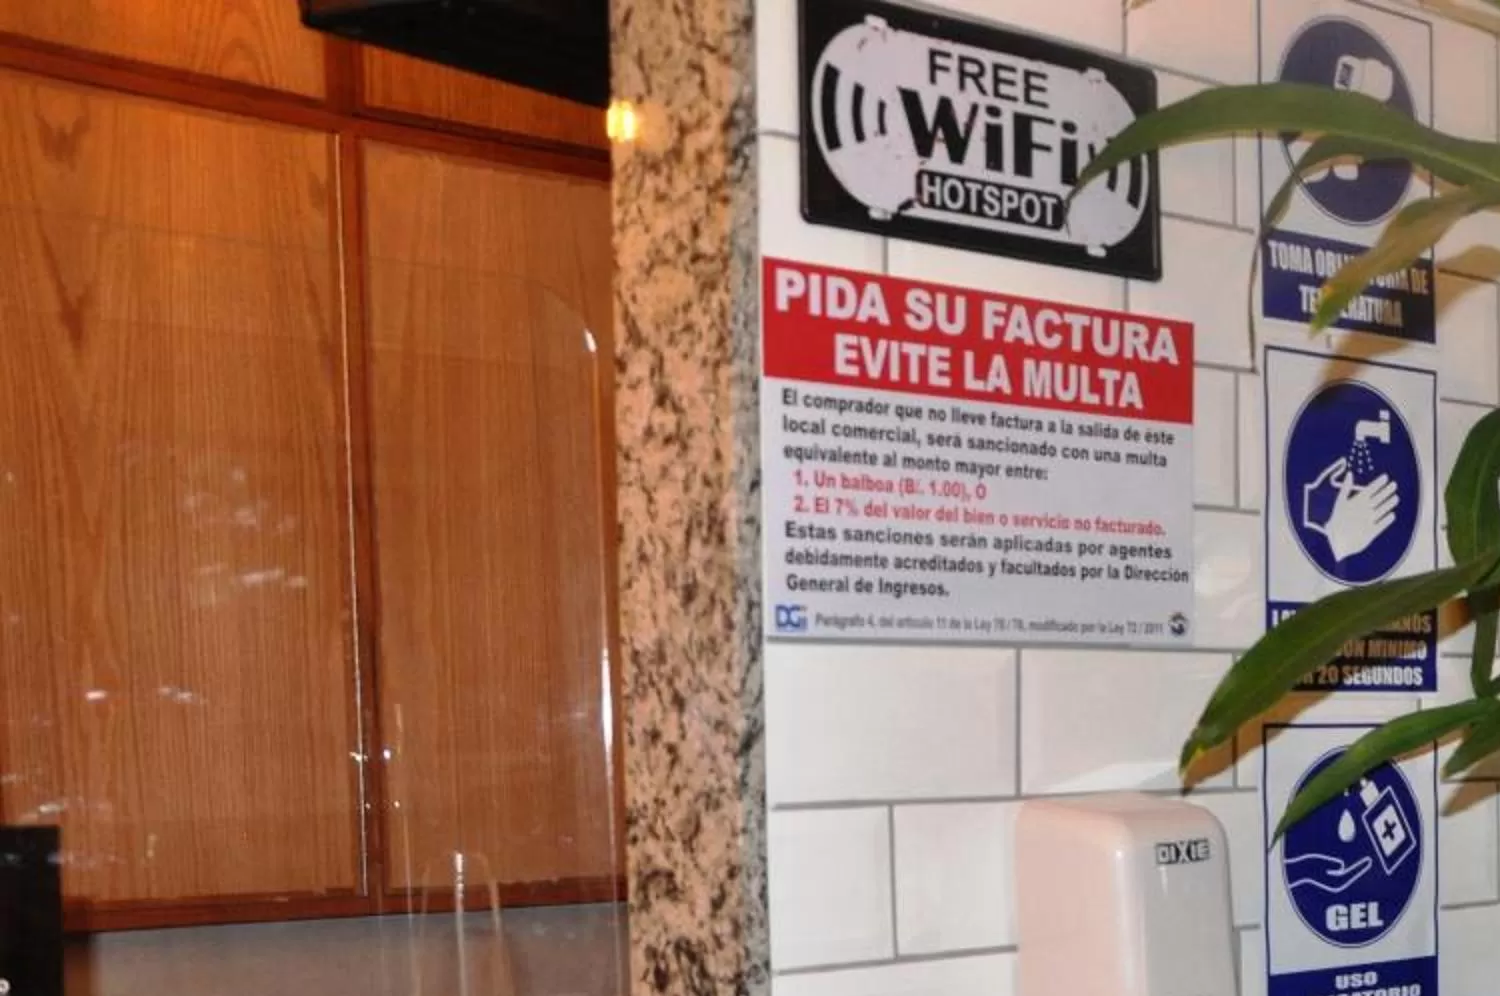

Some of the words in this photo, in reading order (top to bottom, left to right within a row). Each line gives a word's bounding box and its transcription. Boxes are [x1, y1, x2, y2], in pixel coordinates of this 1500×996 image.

[927, 48, 1050, 109] FREE
[896, 85, 1081, 187] WiFi
[921, 174, 1059, 227] HOTSPOT
[1267, 239, 1313, 275] TOMA
[1314, 248, 1409, 291] OBLORIA
[1410, 267, 1429, 295] DE
[774, 267, 890, 327] PIDA
[904, 288, 966, 336] SU
[982, 300, 1179, 366] FACTURA
[1298, 283, 1403, 327] TERATURA
[833, 332, 952, 387] EVITE
[964, 350, 1012, 397] LA
[1022, 360, 1144, 410] MULTA
[781, 387, 798, 405] El
[802, 393, 890, 416] comprador
[894, 405, 923, 422] que
[928, 407, 947, 422] no
[951, 407, 986, 426] lleve
[991, 412, 1043, 431] factura
[1047, 420, 1057, 433] a
[1061, 419, 1074, 435] la
[1077, 422, 1119, 440] salida
[1123, 425, 1142, 442] de
[782, 413, 826, 435] local
[831, 423, 921, 447] comercial,
[966, 435, 1057, 458] sancionado
[1060, 445, 1089, 461] con
[1093, 449, 1121, 463] una
[1125, 450, 1167, 468] multa
[783, 443, 878, 466] equivalente
[882, 451, 897, 468] al
[901, 455, 951, 472] monto
[955, 461, 1000, 480] mayor
[1005, 463, 1049, 480] entre:
[793, 470, 809, 487] 1.
[813, 470, 837, 489] Un
[840, 474, 895, 494] balboa
[793, 495, 810, 513] 2.
[814, 497, 830, 513] El
[836, 499, 860, 516] 7%
[863, 501, 889, 518] del
[892, 504, 932, 521] valor
[934, 505, 959, 523] del
[963, 508, 994, 525] bien
[999, 513, 1009, 527] o
[1012, 513, 1070, 530] servicio
[1073, 518, 1092, 532] no
[1095, 516, 1167, 536] facturado.
[784, 520, 838, 540] Estas
[843, 526, 935, 546] sanciones
[939, 531, 989, 548] serán
[993, 534, 1073, 555] aplicadas
[1077, 541, 1105, 558] por
[1109, 544, 1173, 561] agentes
[784, 547, 890, 569] debidamente
[893, 554, 985, 575] acreditados
[987, 562, 998, 578] y
[1000, 559, 1077, 578] facultados
[1080, 566, 1104, 582] por
[1107, 564, 1121, 580] la
[1124, 565, 1190, 584] Dirección
[786, 573, 850, 594] General
[854, 576, 875, 593] de
[878, 577, 951, 599] Ingresos.
[1317, 664, 1340, 684] 20
[1342, 665, 1424, 686] SEGUNDOS
[1325, 902, 1384, 931] GEL
[1334, 971, 1379, 990] USO
